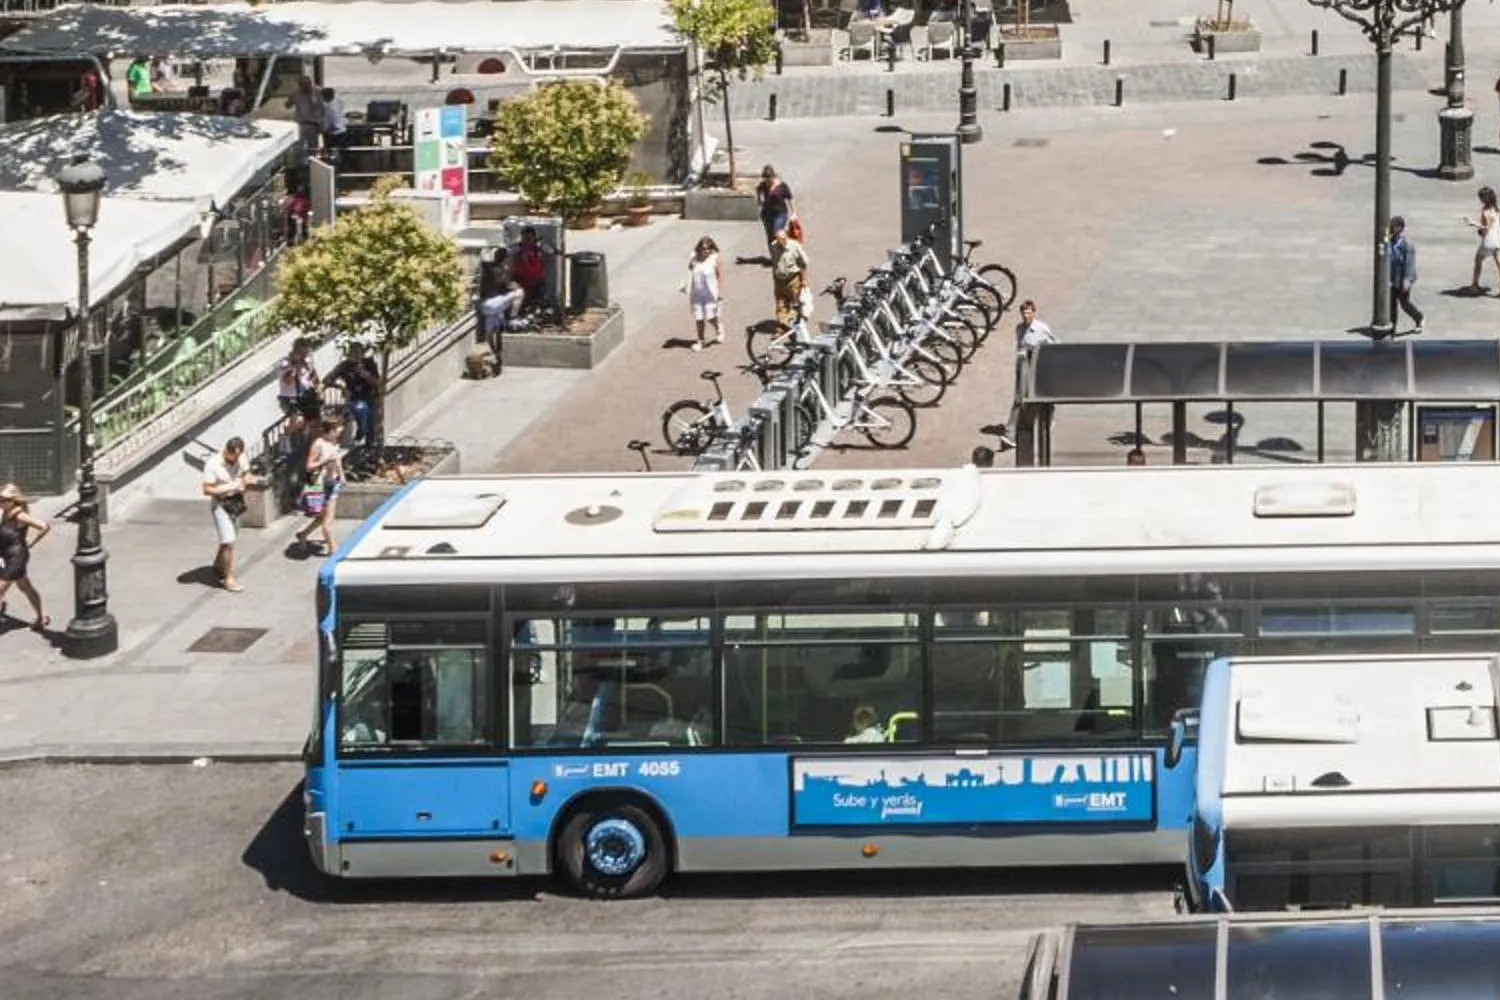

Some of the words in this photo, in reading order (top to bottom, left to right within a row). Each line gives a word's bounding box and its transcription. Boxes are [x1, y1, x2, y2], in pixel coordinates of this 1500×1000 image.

[593, 763, 629, 777] EMT
[833, 793, 866, 807] Sube
[1088, 791, 1127, 807] EMT
